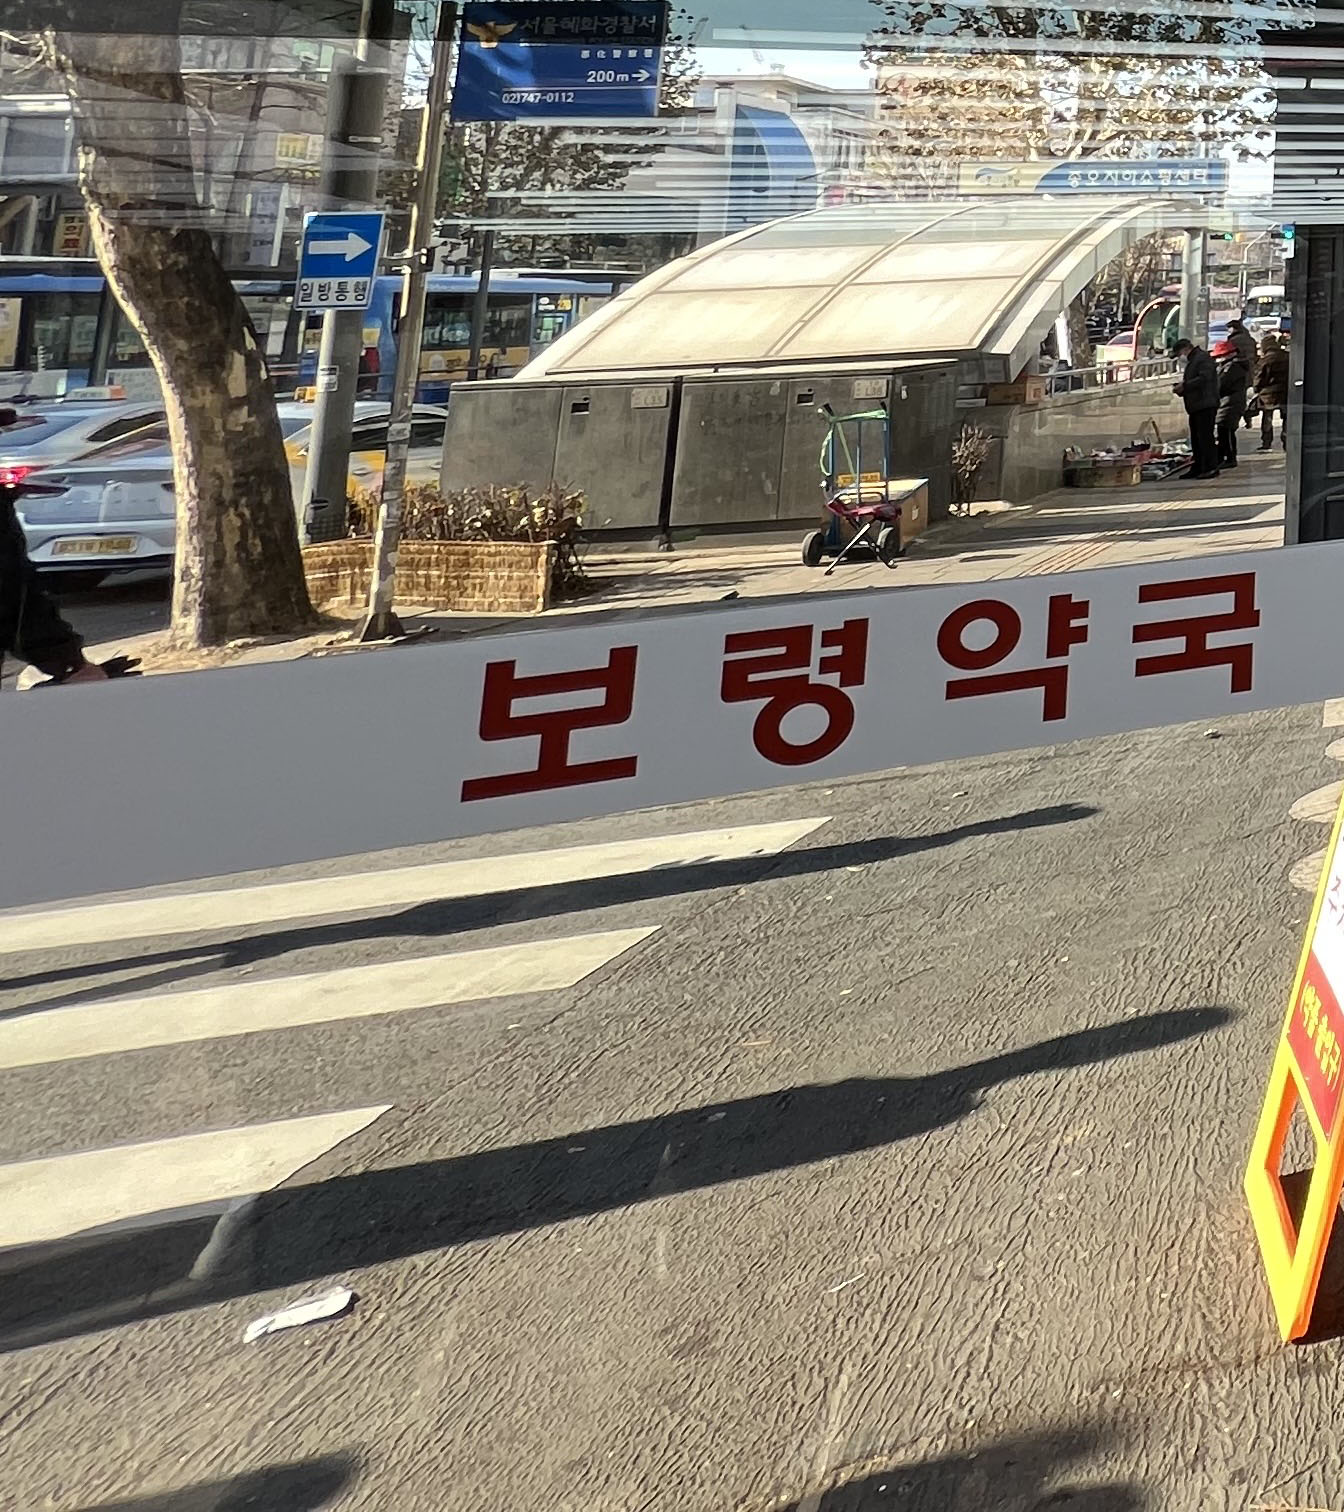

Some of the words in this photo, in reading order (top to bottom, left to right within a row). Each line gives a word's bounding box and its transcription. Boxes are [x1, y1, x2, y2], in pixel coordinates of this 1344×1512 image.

[520, 16, 656, 35] 서울혜화경찰서
[502, 92, 574, 104] 02)747-0112
[301, 281, 367, 302] 일방통행
[461, 572, 1260, 802] 보령약국
